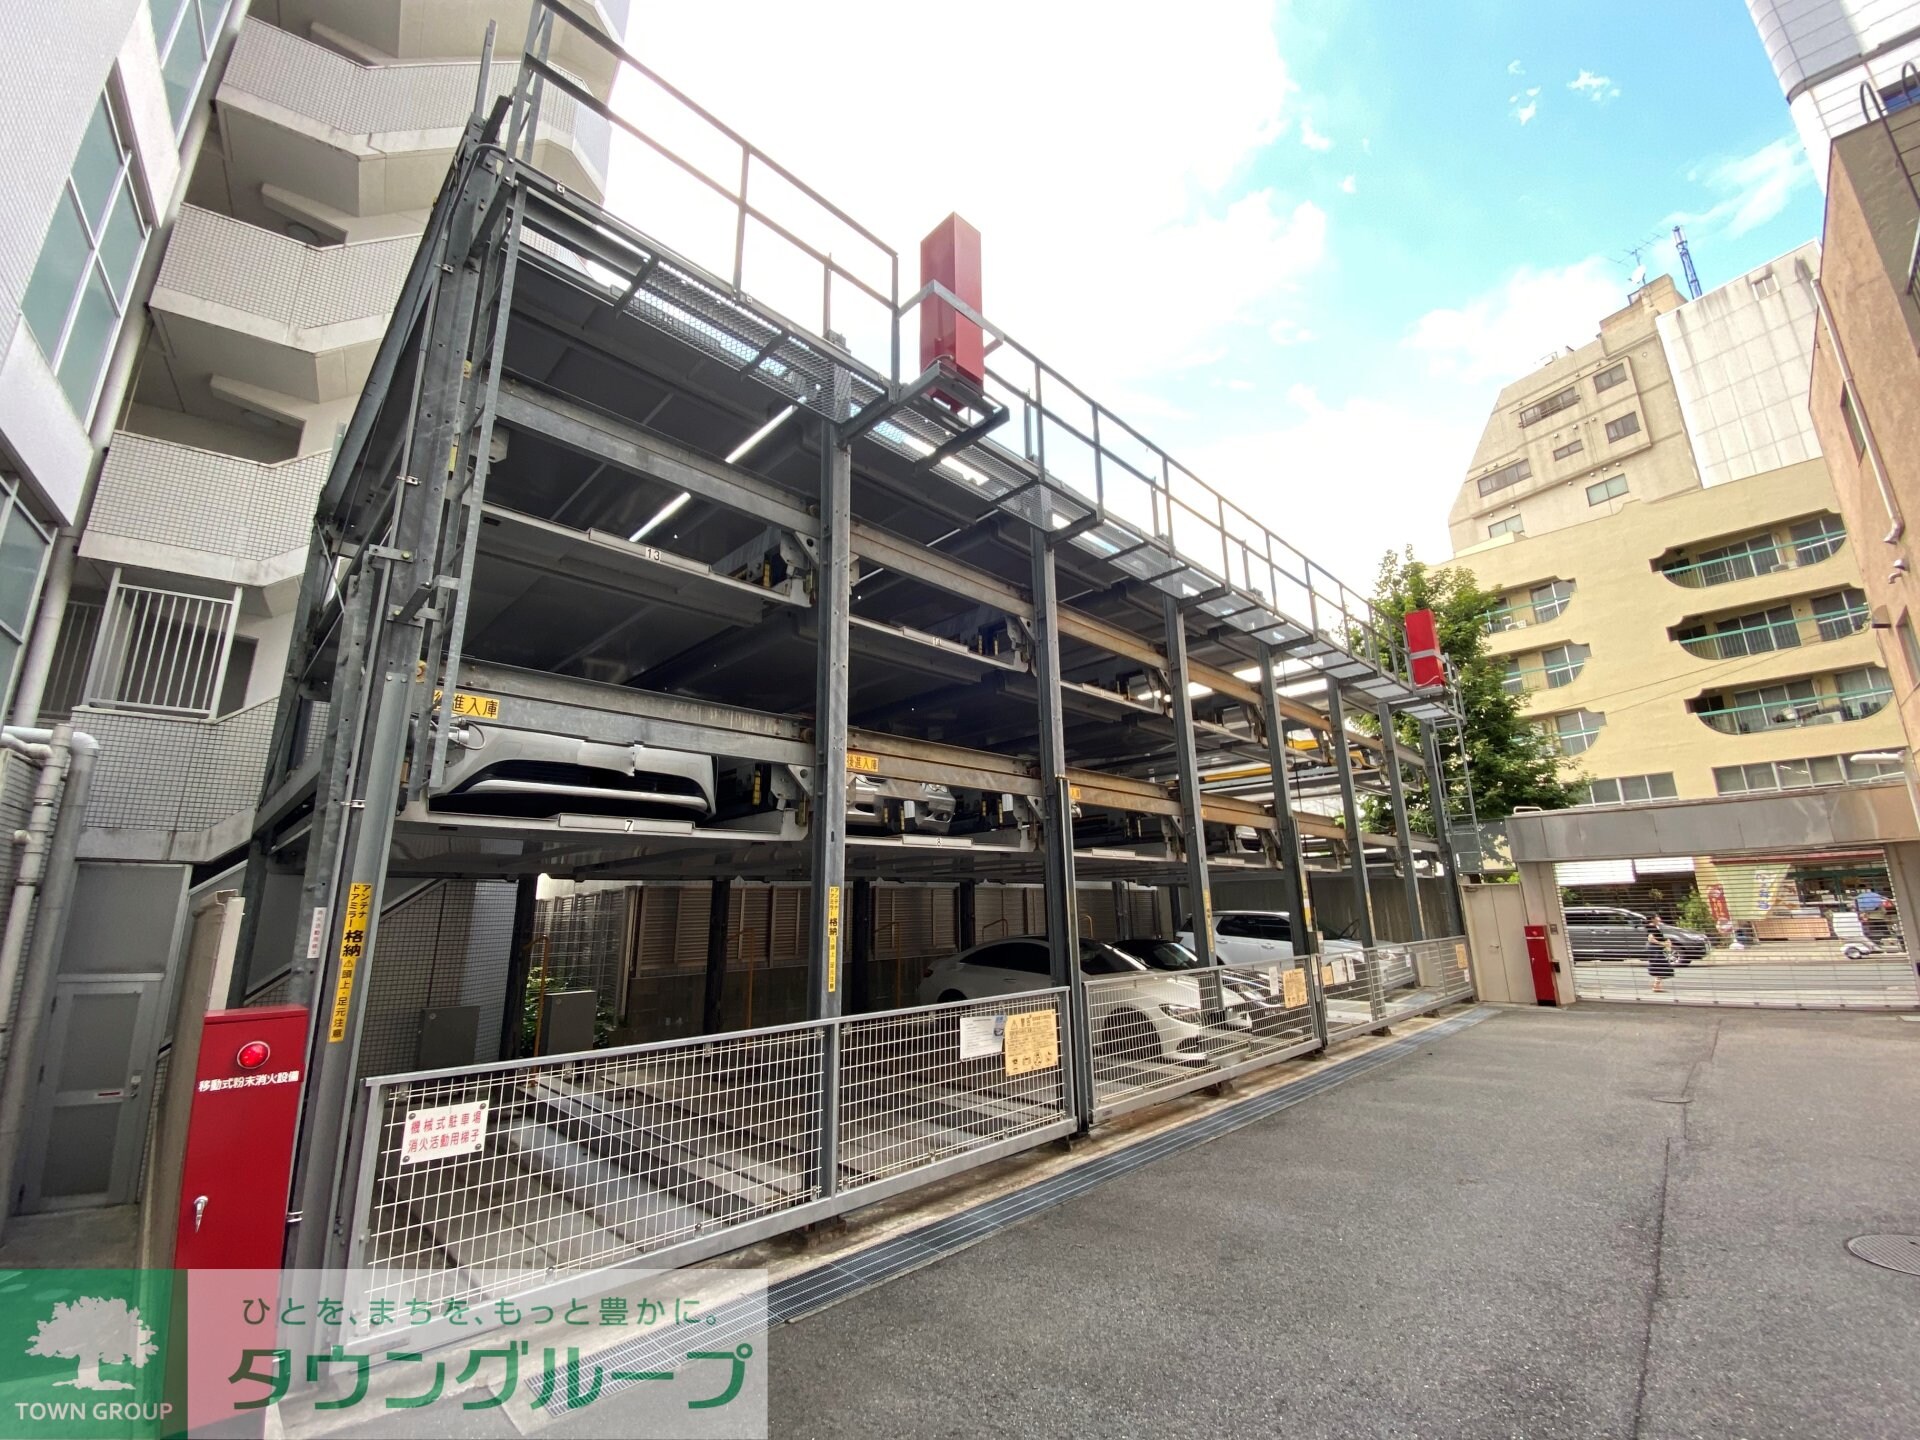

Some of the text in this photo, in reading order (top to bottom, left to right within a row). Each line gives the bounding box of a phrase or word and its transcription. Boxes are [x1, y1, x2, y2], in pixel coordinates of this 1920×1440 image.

[647, 548, 660, 561] 13
[626, 819, 634, 833] 7
[348, 884, 360, 928] ドアミラー
[358, 884, 372, 919] アンテナ
[342, 929, 364, 957] 格納
[198, 1070, 300, 1092] 移動式粉末消火設備
[410, 1110, 482, 1134] 機械式駐車場
[407, 1128, 480, 1153] 消火活動用梯子
